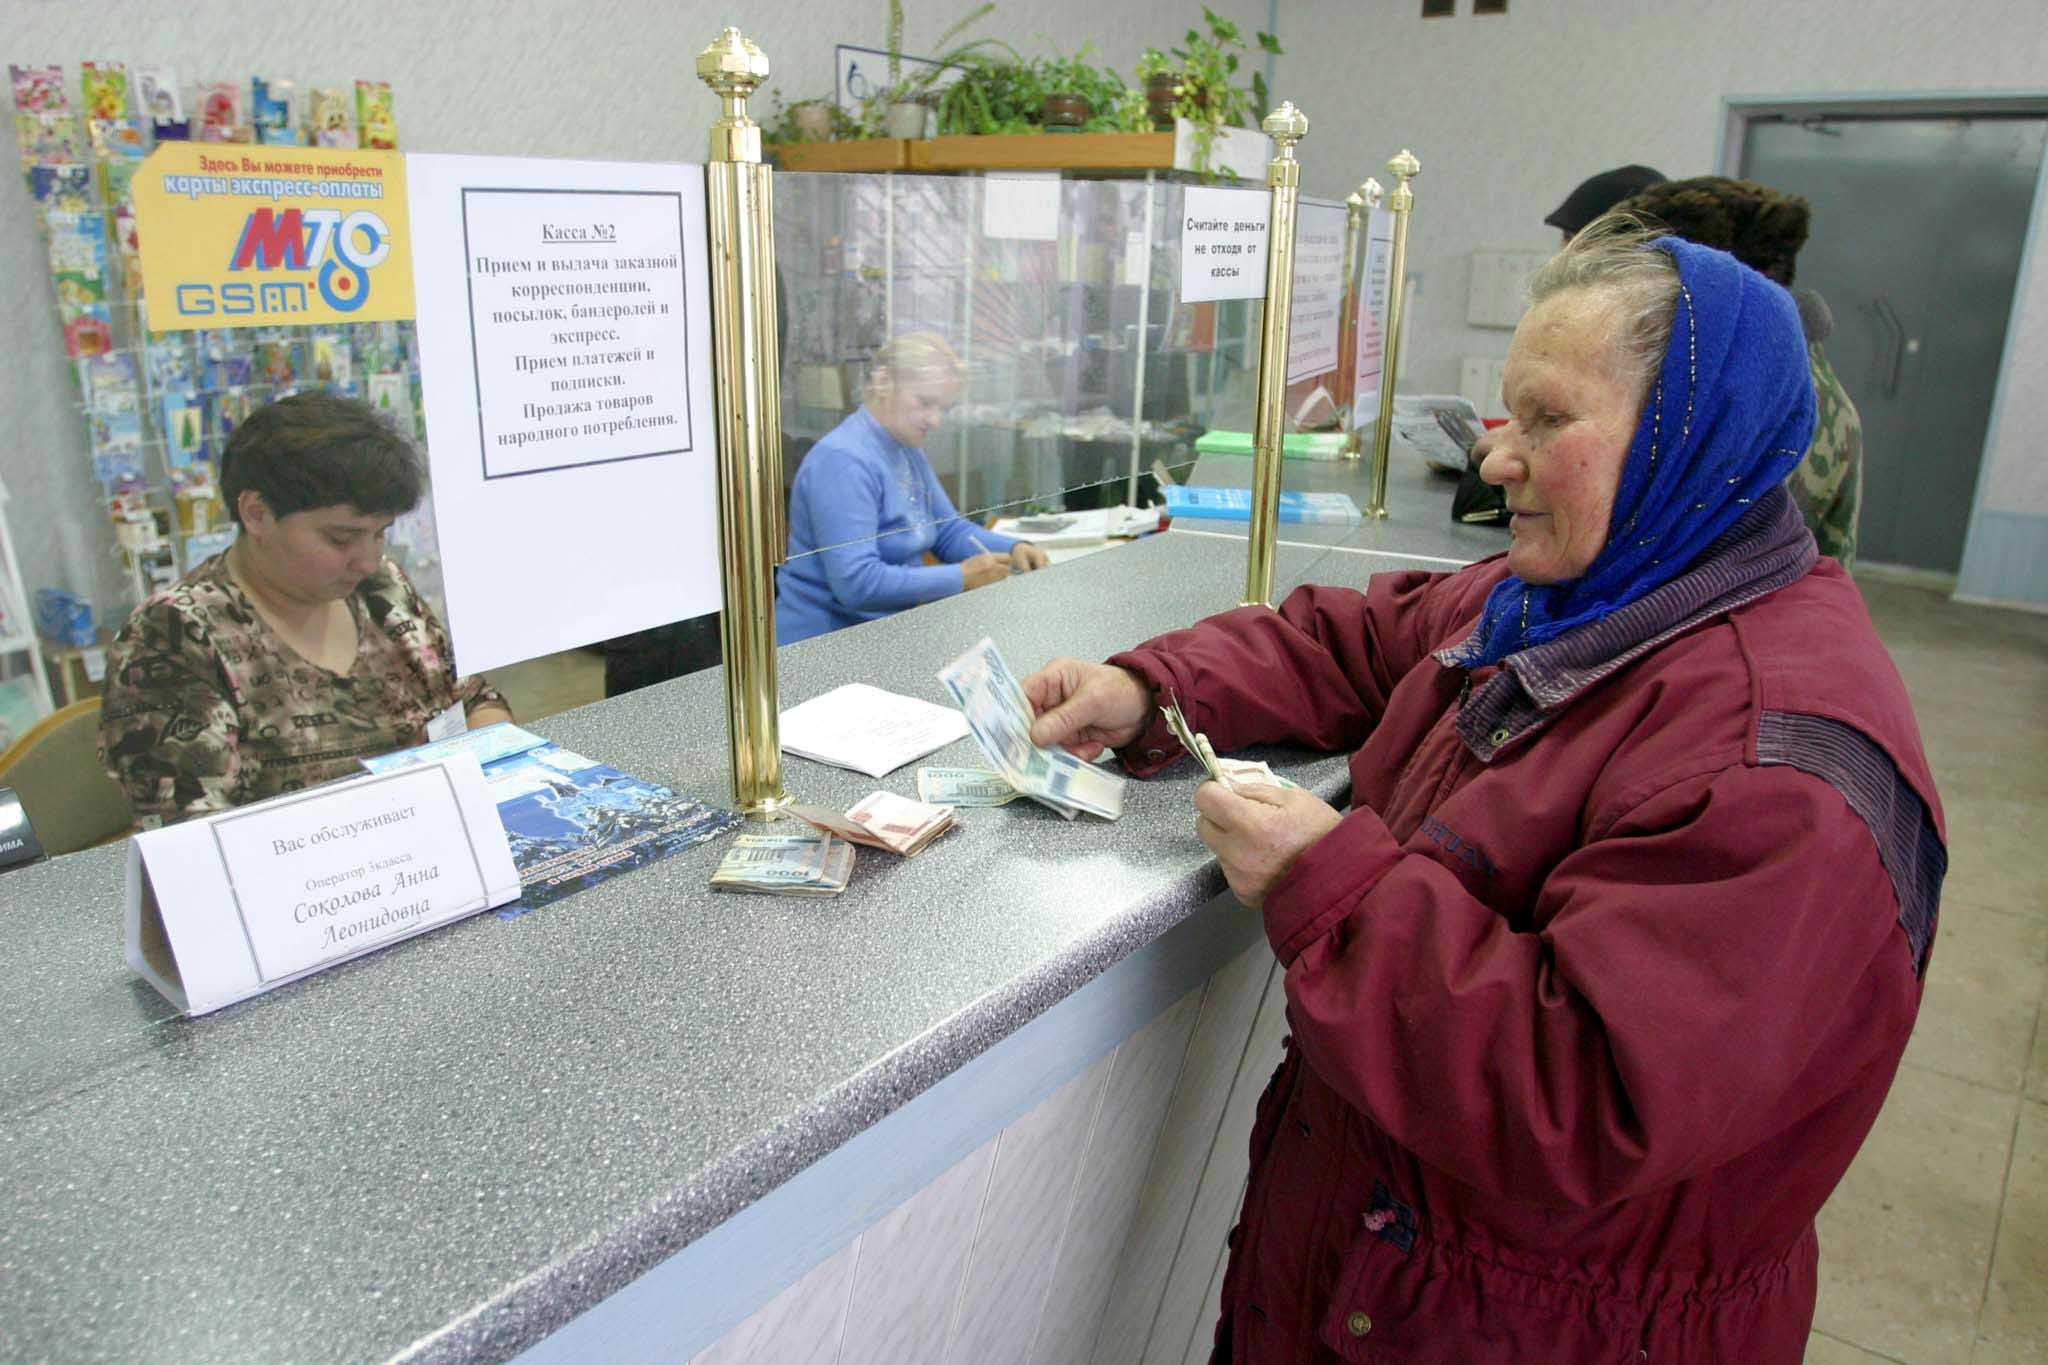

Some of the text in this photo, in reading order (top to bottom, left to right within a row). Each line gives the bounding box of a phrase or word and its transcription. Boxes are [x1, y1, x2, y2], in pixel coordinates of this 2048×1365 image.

[200, 155, 383, 179] Здесь Вы можете приобрести
[164, 175, 383, 200] карты экспресс-оплаты
[542, 223, 617, 241] Касса №2
[1186, 217, 1266, 233] Считайте деньги
[228, 207, 391, 271] МТС
[1194, 244, 1257, 255] не отходя от
[476, 254, 678, 276] Прием и выдача заказной
[1210, 267, 1240, 278] кассы
[176, 282, 307, 315] GSM
[571, 301, 656, 321] бандеролей
[659, 303, 669, 315] и
[550, 330, 621, 347] экспресс.
[515, 348, 655, 375] Прием платежей и
[551, 375, 626, 393] подписки.
[523, 393, 654, 422] Продажа товаров
[498, 413, 678, 447] народного потребления.
[272, 805, 416, 856] Вас обслуживает
[305, 866, 366, 892] Оператор
[294, 864, 440, 924] Соколова Анна
[320, 898, 431, 950] Леонидовна
